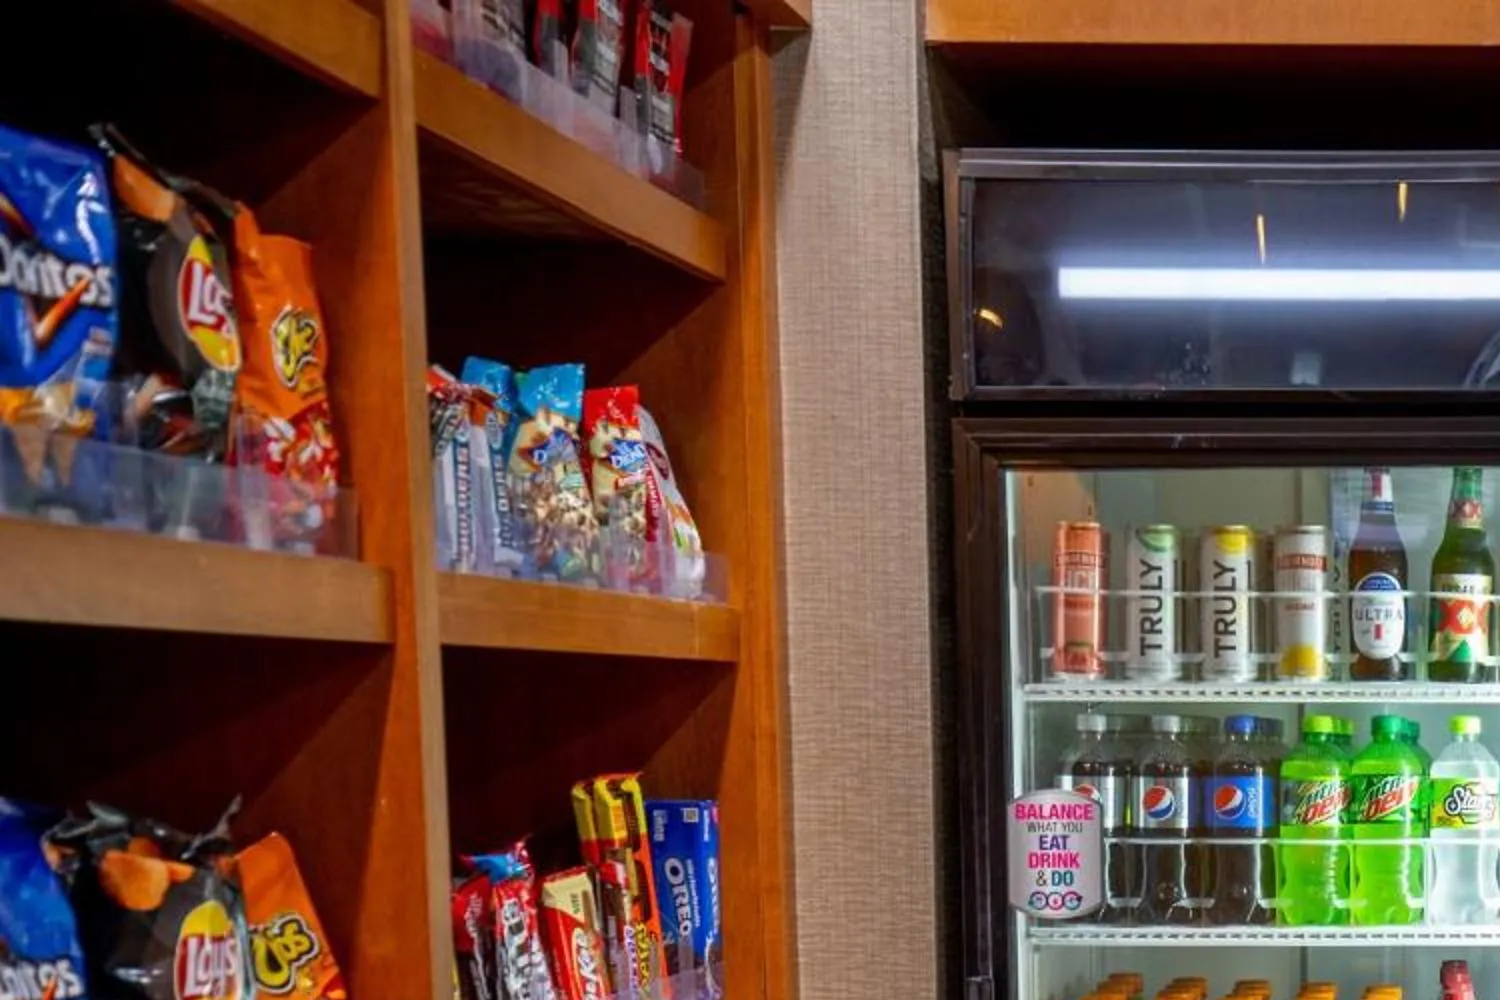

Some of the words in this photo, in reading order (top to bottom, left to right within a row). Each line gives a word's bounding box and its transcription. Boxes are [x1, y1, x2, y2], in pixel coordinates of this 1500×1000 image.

[1140, 558, 1163, 657] TRULY
[1214, 559, 1237, 658] TRULY
[1015, 803, 1094, 820] BALANCE
[1027, 822, 1056, 833] WHAT
[1062, 822, 1083, 833] YOU
[1039, 835, 1069, 850] EAT
[1028, 852, 1080, 869] DRINK
[1036, 870, 1047, 887] &
[1051, 870, 1074, 886] DO
[664, 857, 693, 936] OREO
